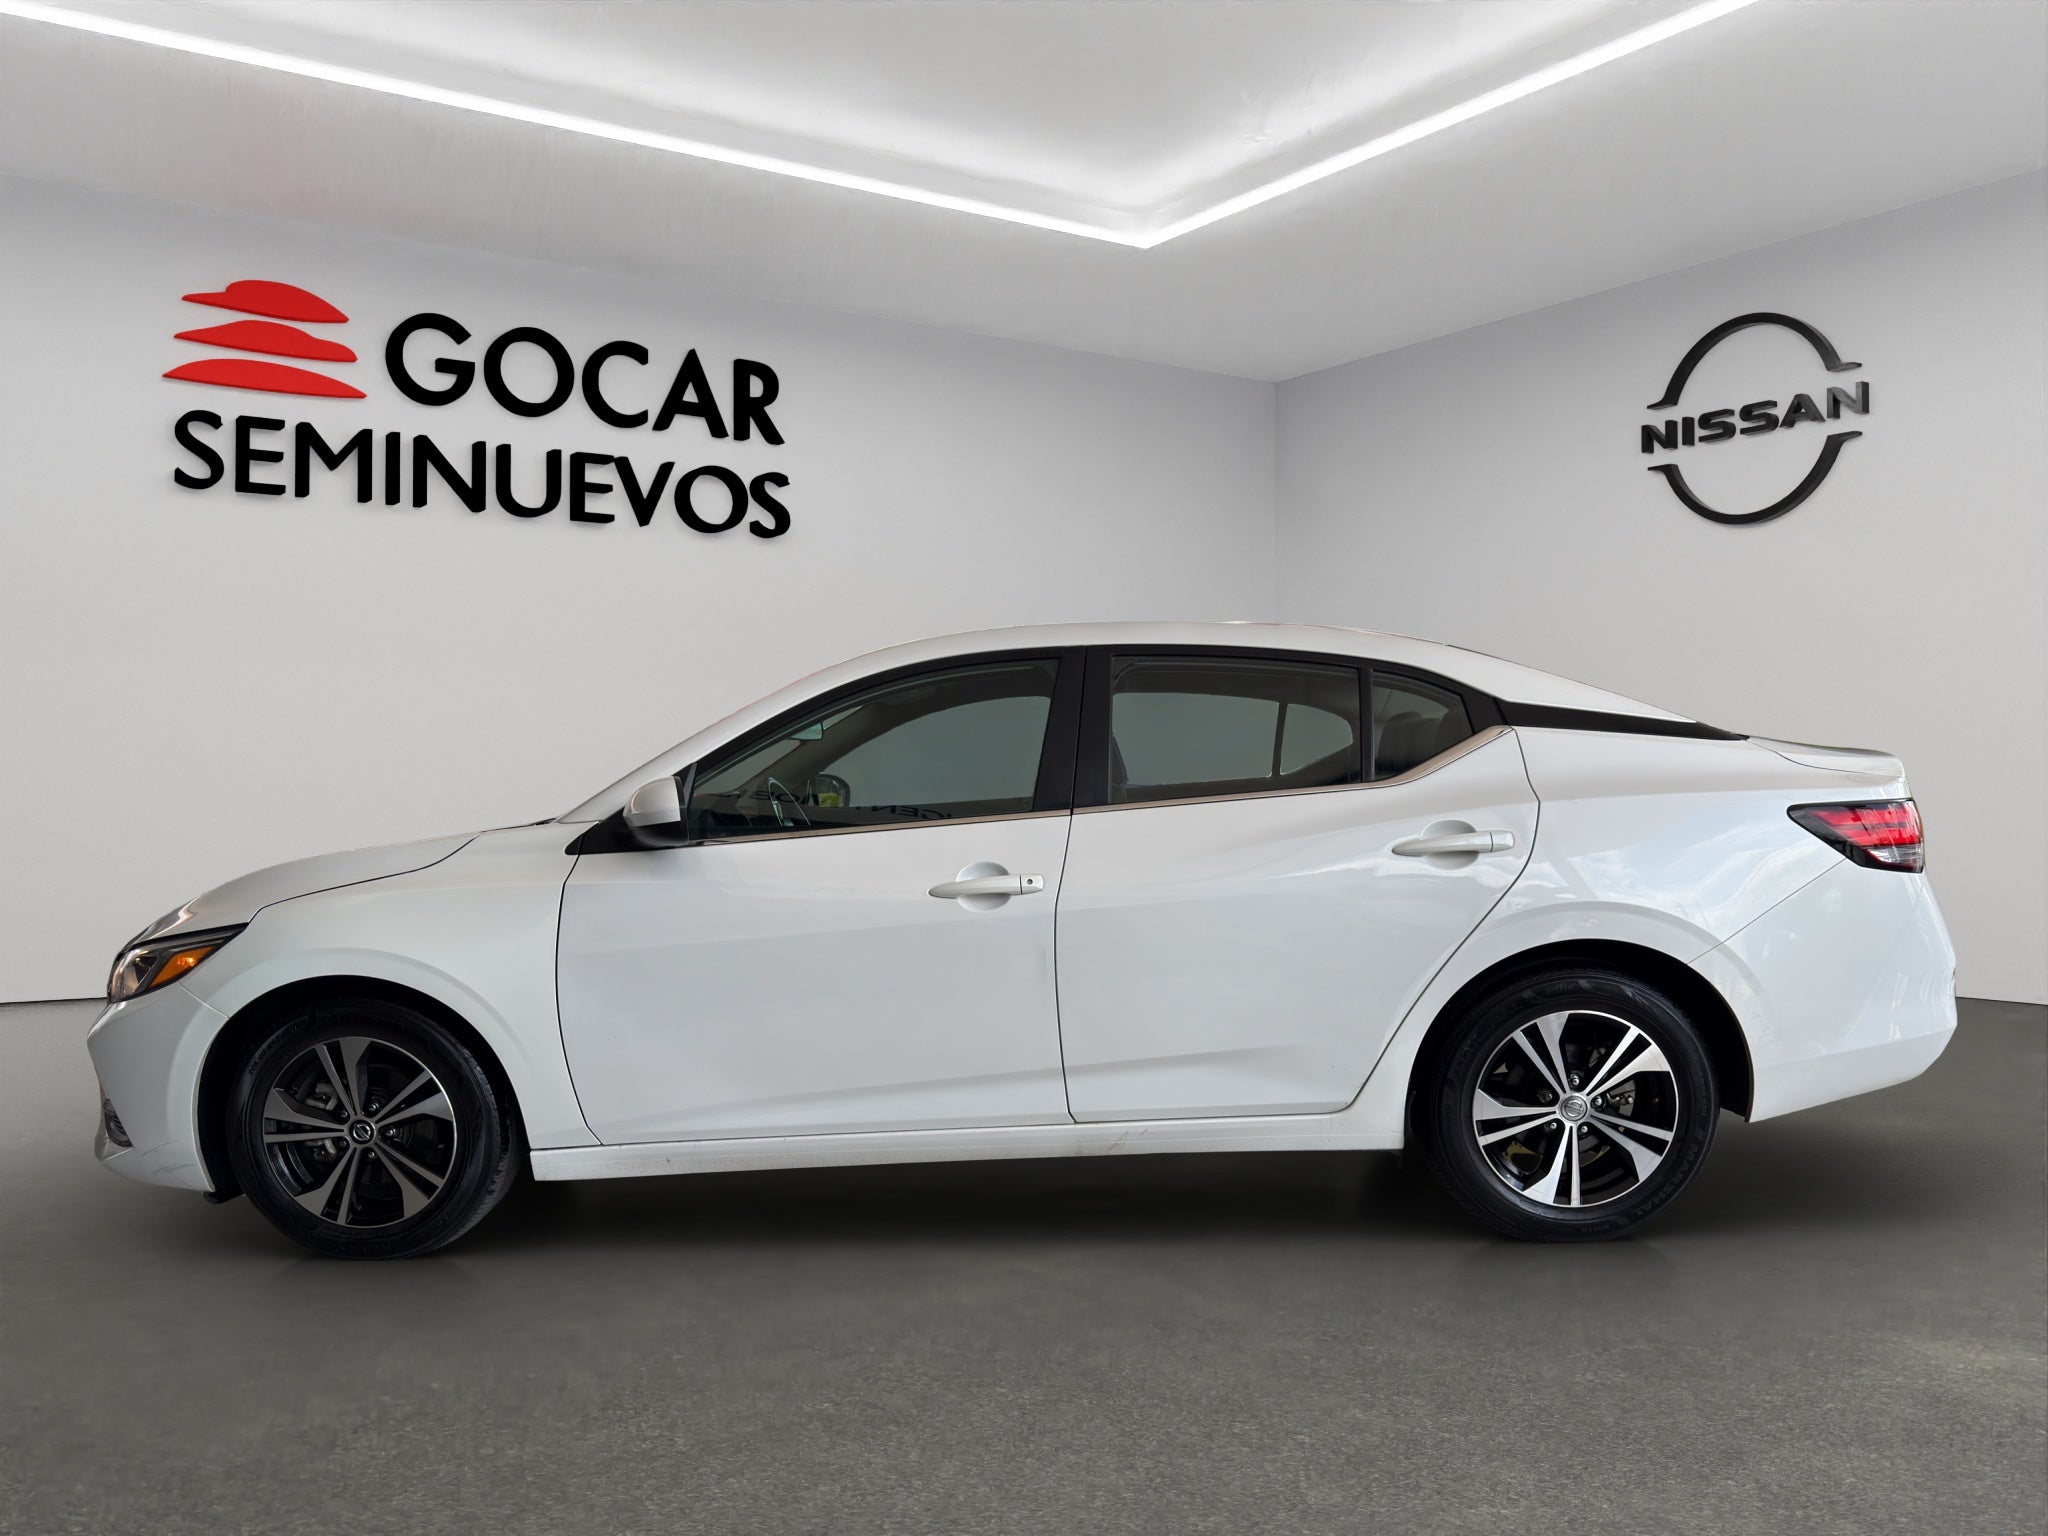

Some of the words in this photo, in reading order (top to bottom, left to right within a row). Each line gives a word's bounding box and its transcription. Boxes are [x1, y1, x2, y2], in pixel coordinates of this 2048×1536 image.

[385, 313, 785, 445] GOCAR
[1641, 381, 1870, 454] NISSAN
[174, 410, 791, 539] SEMINUEVOS
[1631, 1142, 1700, 1216] MARSHAL
